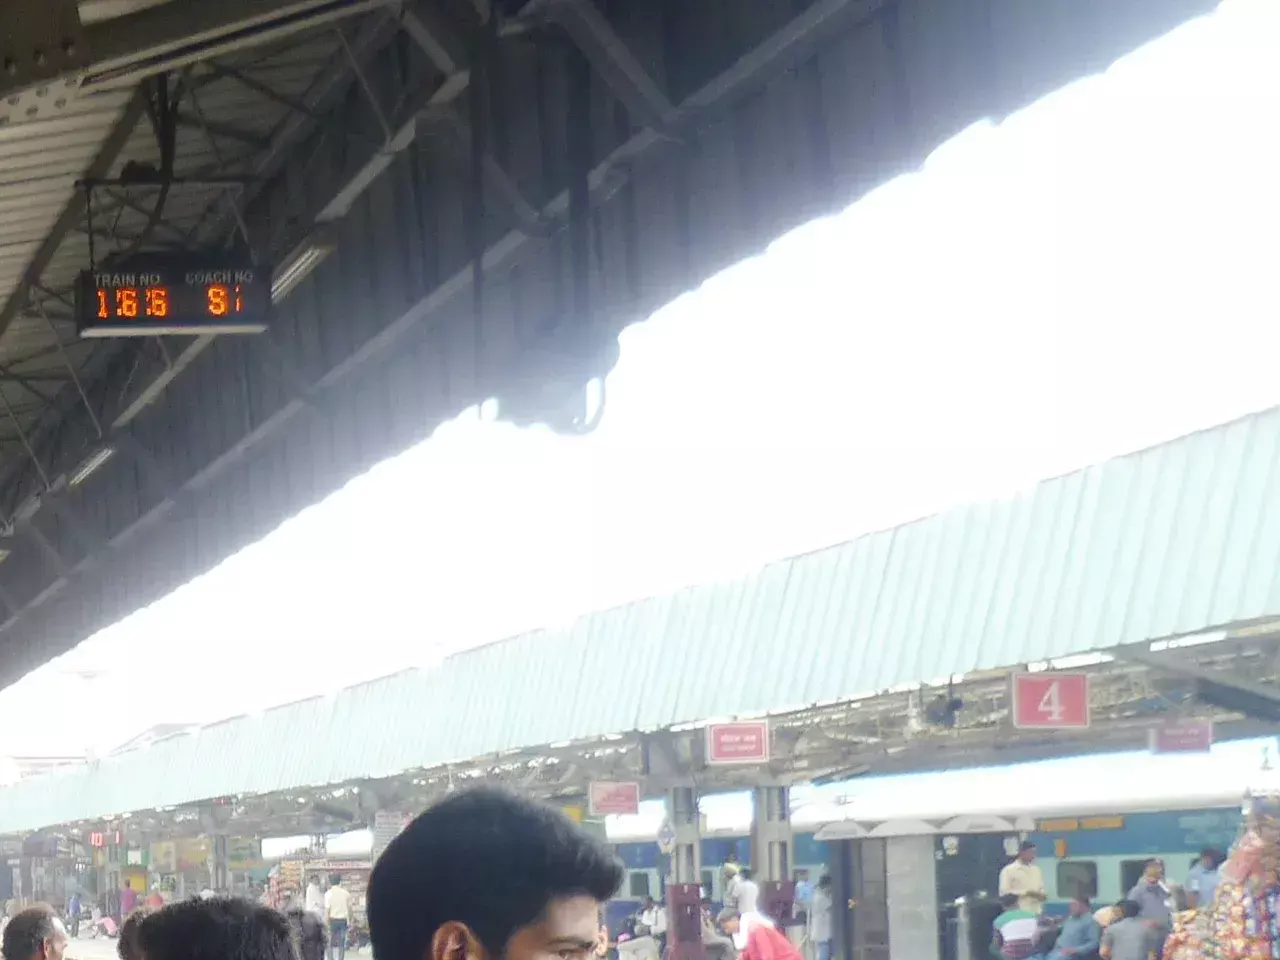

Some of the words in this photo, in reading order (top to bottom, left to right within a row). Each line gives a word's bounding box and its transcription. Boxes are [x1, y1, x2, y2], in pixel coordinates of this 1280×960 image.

[93, 274, 135, 288] TRAIN
[185, 271, 231, 284] COACH
[1037, 680, 1066, 721] 4
